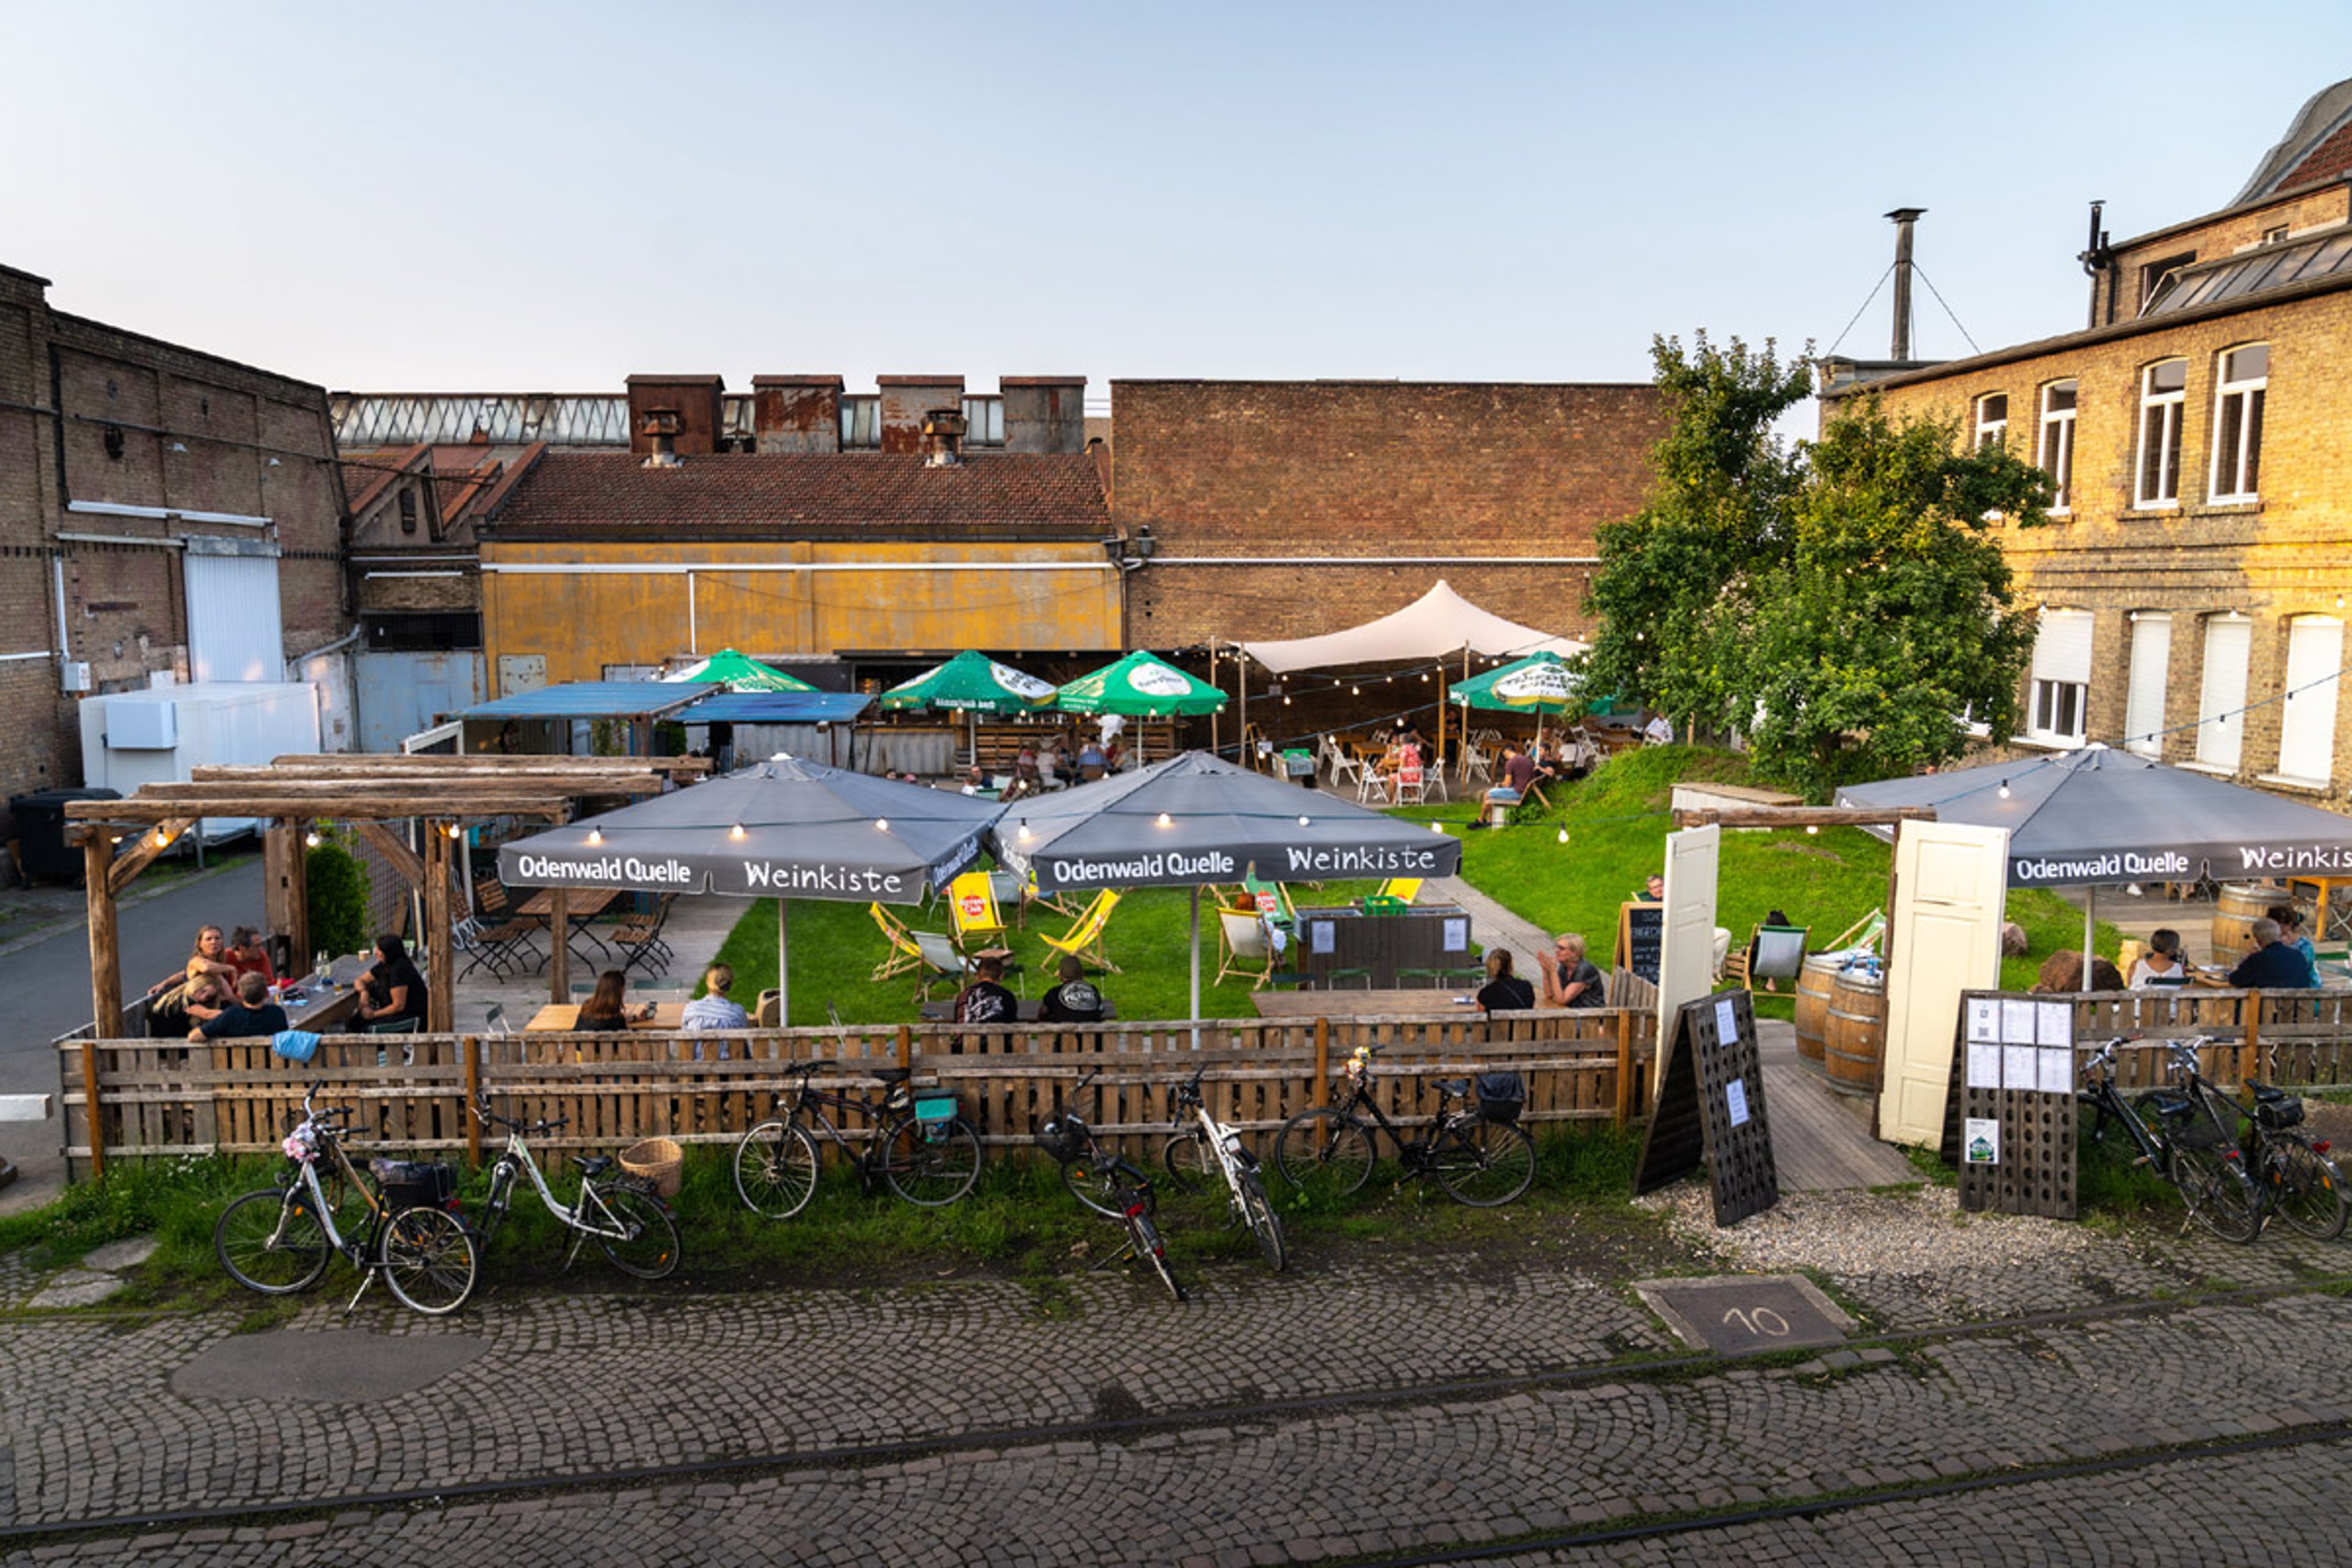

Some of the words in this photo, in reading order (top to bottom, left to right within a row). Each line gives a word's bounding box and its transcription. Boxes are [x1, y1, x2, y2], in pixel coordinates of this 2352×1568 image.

[518, 855, 622, 881] Odenwald
[625, 857, 692, 883] Quelle
[1054, 854, 1163, 883] Odenwald
[1167, 851, 1234, 876] Quelle
[1286, 845, 1436, 871] Weinkiste
[2016, 854, 2121, 880] Odenwald
[2124, 851, 2189, 875] Quelle
[2239, 845, 2352, 869] Weinkis
[743, 861, 903, 894] Weinkiste
[1722, 1306, 1790, 1336] 10
